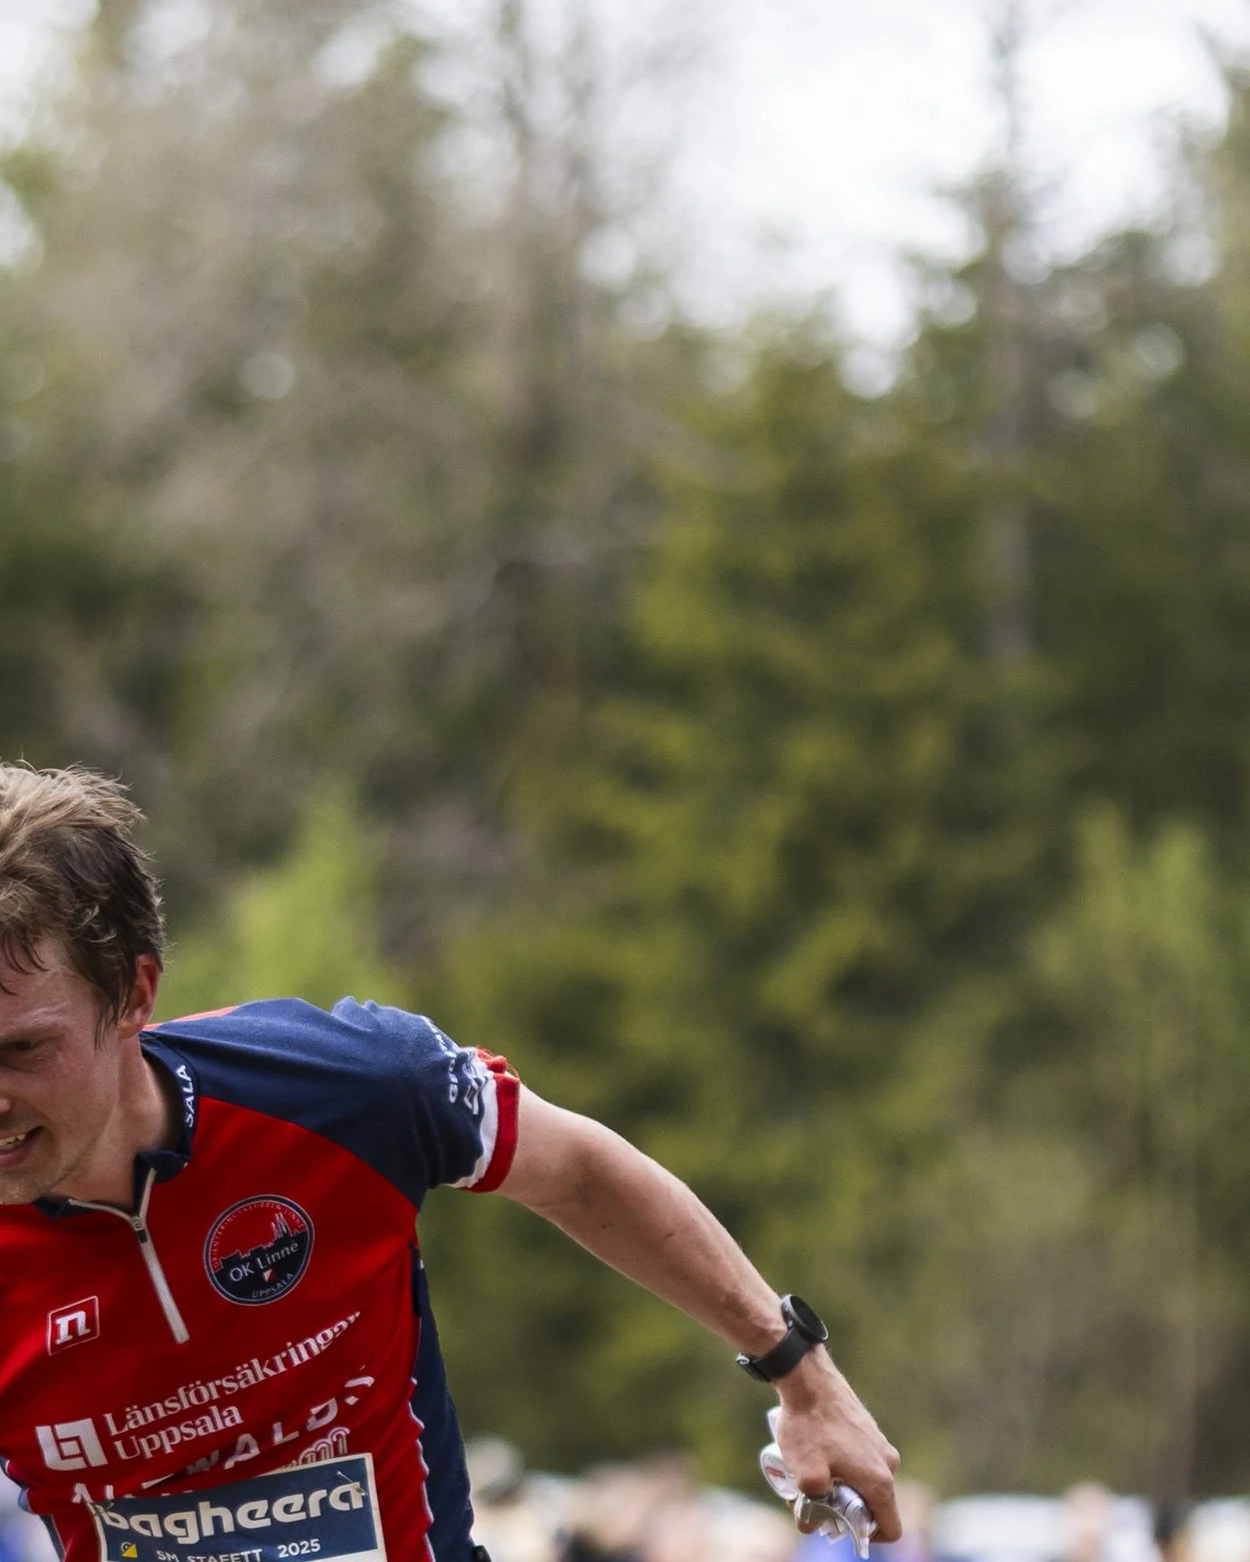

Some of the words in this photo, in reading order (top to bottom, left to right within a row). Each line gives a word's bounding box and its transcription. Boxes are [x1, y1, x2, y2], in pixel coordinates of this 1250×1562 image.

[229, 1262, 254, 1282] OK
[256, 1239, 300, 1269] Linné
[113, 1404, 245, 1462] Uppsala
[99, 1481, 366, 1545] bagheera
[278, 1538, 322, 1559] 2025
